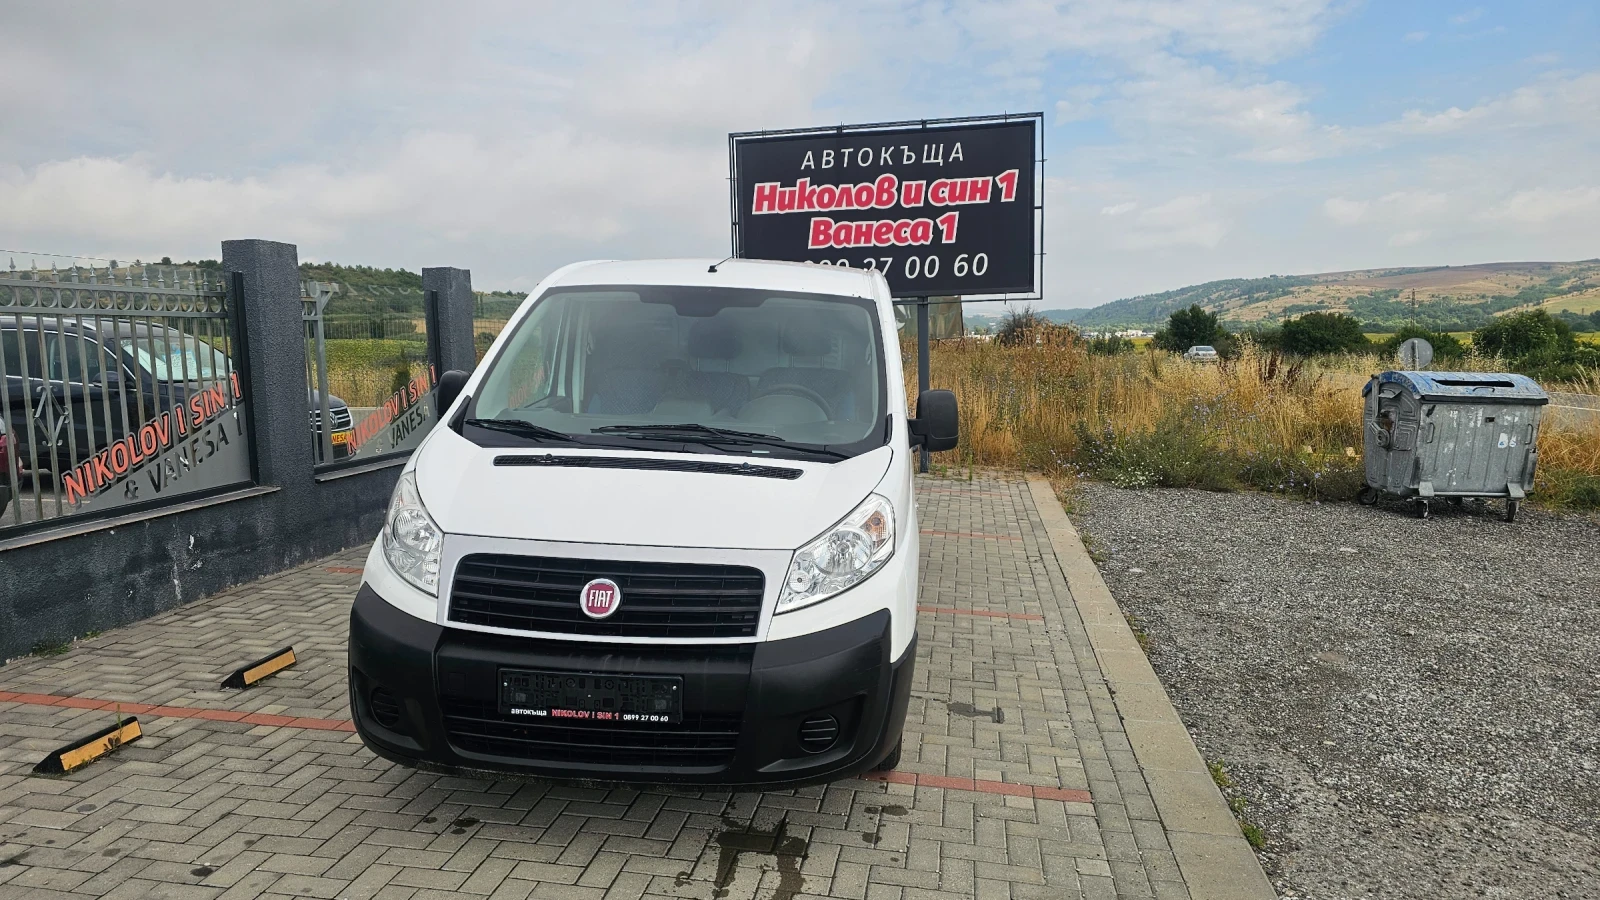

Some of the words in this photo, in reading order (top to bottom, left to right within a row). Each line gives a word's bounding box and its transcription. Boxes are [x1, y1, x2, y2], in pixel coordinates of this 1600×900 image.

[801, 142, 964, 170] АВТОКЪЩА
[752, 173, 898, 215] Николов
[901, 180, 926, 208] и
[929, 176, 994, 206] син
[995, 169, 1019, 203] 1
[808, 217, 934, 249] Ванеса
[937, 211, 960, 244] 1
[904, 256, 940, 279] 00
[953, 253, 989, 277] 60
[347, 391, 400, 456] NIKOLOV
[408, 373, 430, 404] SIN
[429, 363, 437, 386] 1
[387, 400, 430, 449] VANESA
[62, 412, 170, 505] NIKOLOV
[174, 404, 188, 436] I
[189, 380, 228, 428] SIN
[230, 370, 242, 400] 1
[124, 480, 139, 500] &
[146, 422, 229, 493] VANESA
[588, 589, 613, 608] FIAT
[510, 708, 547, 717] автокъща
[551, 709, 590, 718] NIKOLOV
[597, 711, 612, 720] SIN
[614, 712, 619, 720] 1
